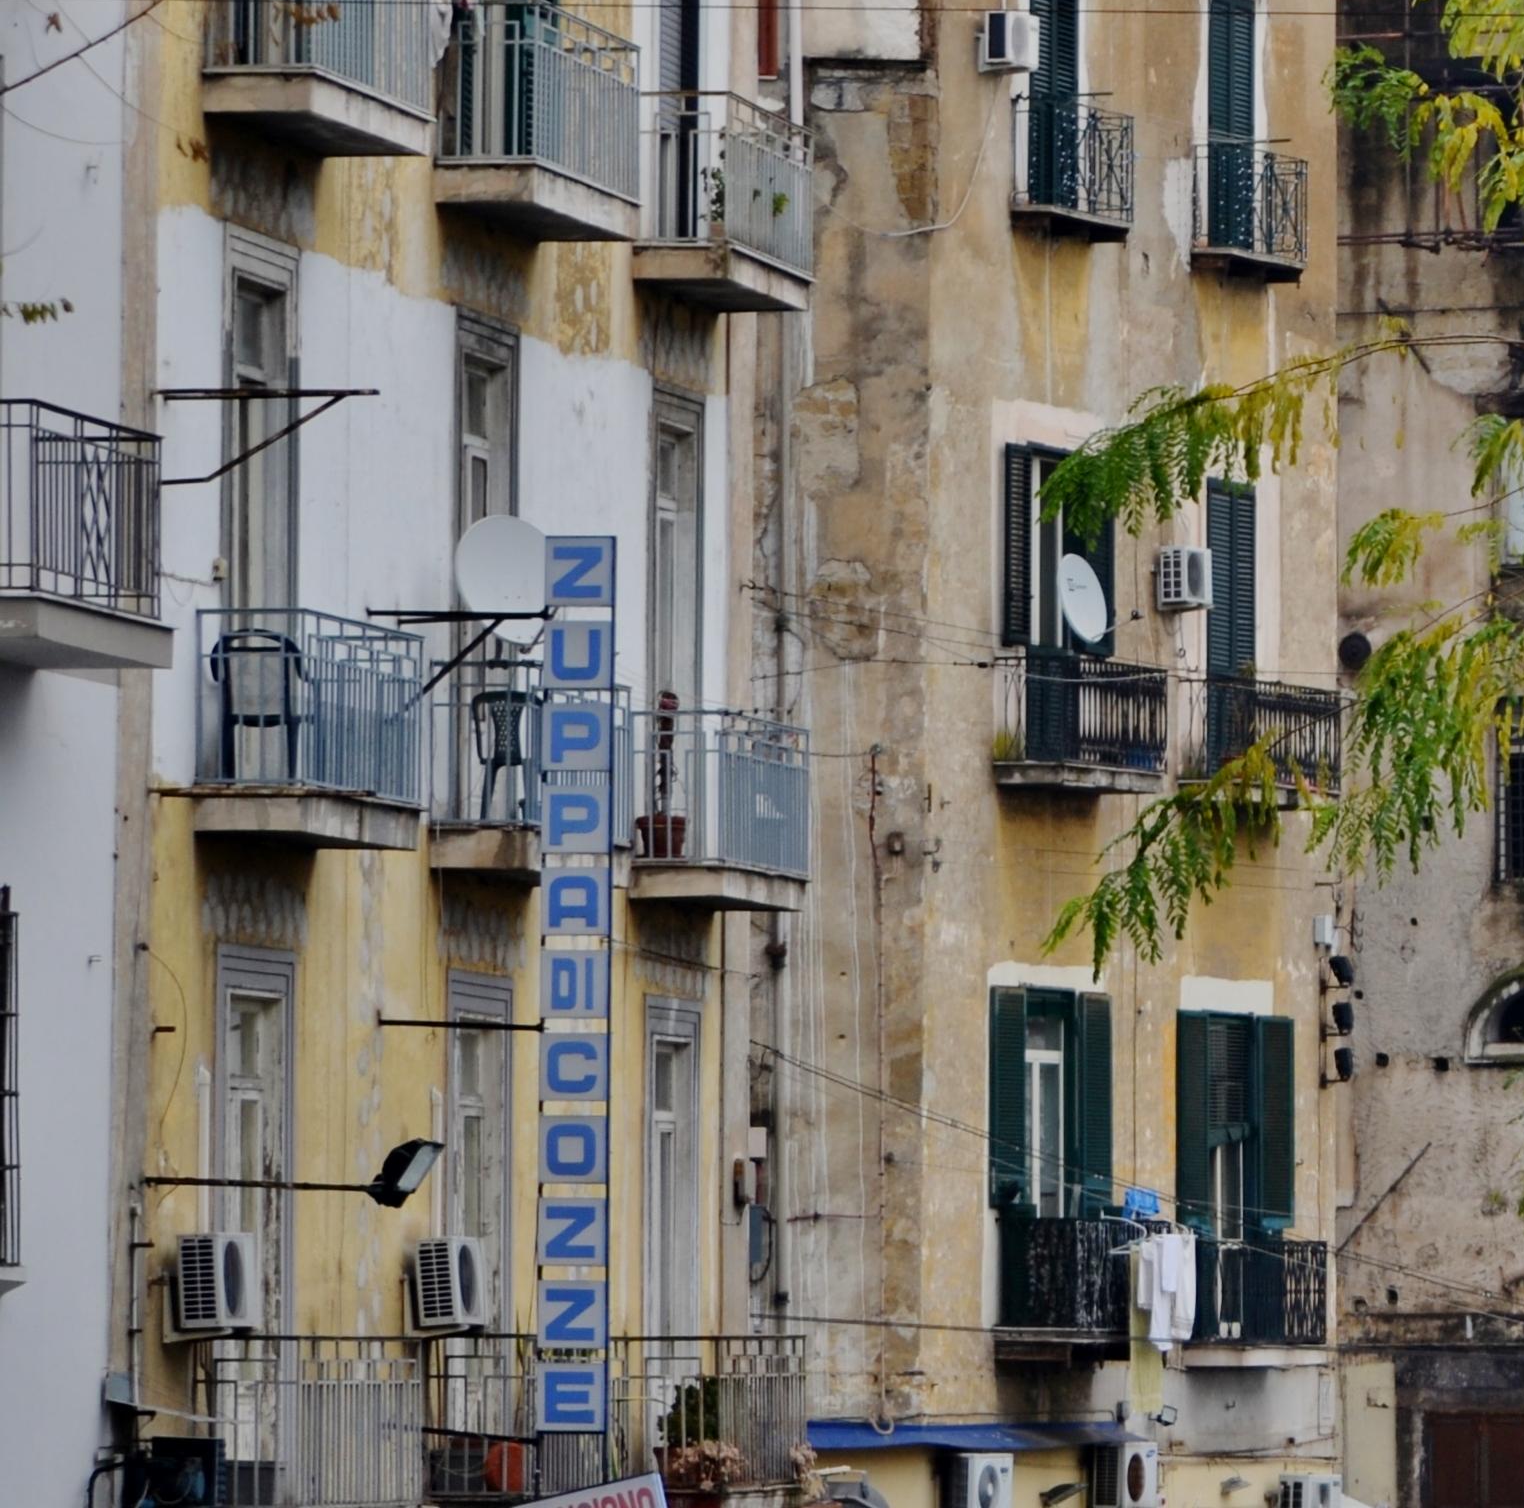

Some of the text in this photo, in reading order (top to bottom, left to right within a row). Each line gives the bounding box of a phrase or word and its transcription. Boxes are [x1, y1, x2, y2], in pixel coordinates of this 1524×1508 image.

[543, 546, 603, 1424] ZUPPA DI COZZE
